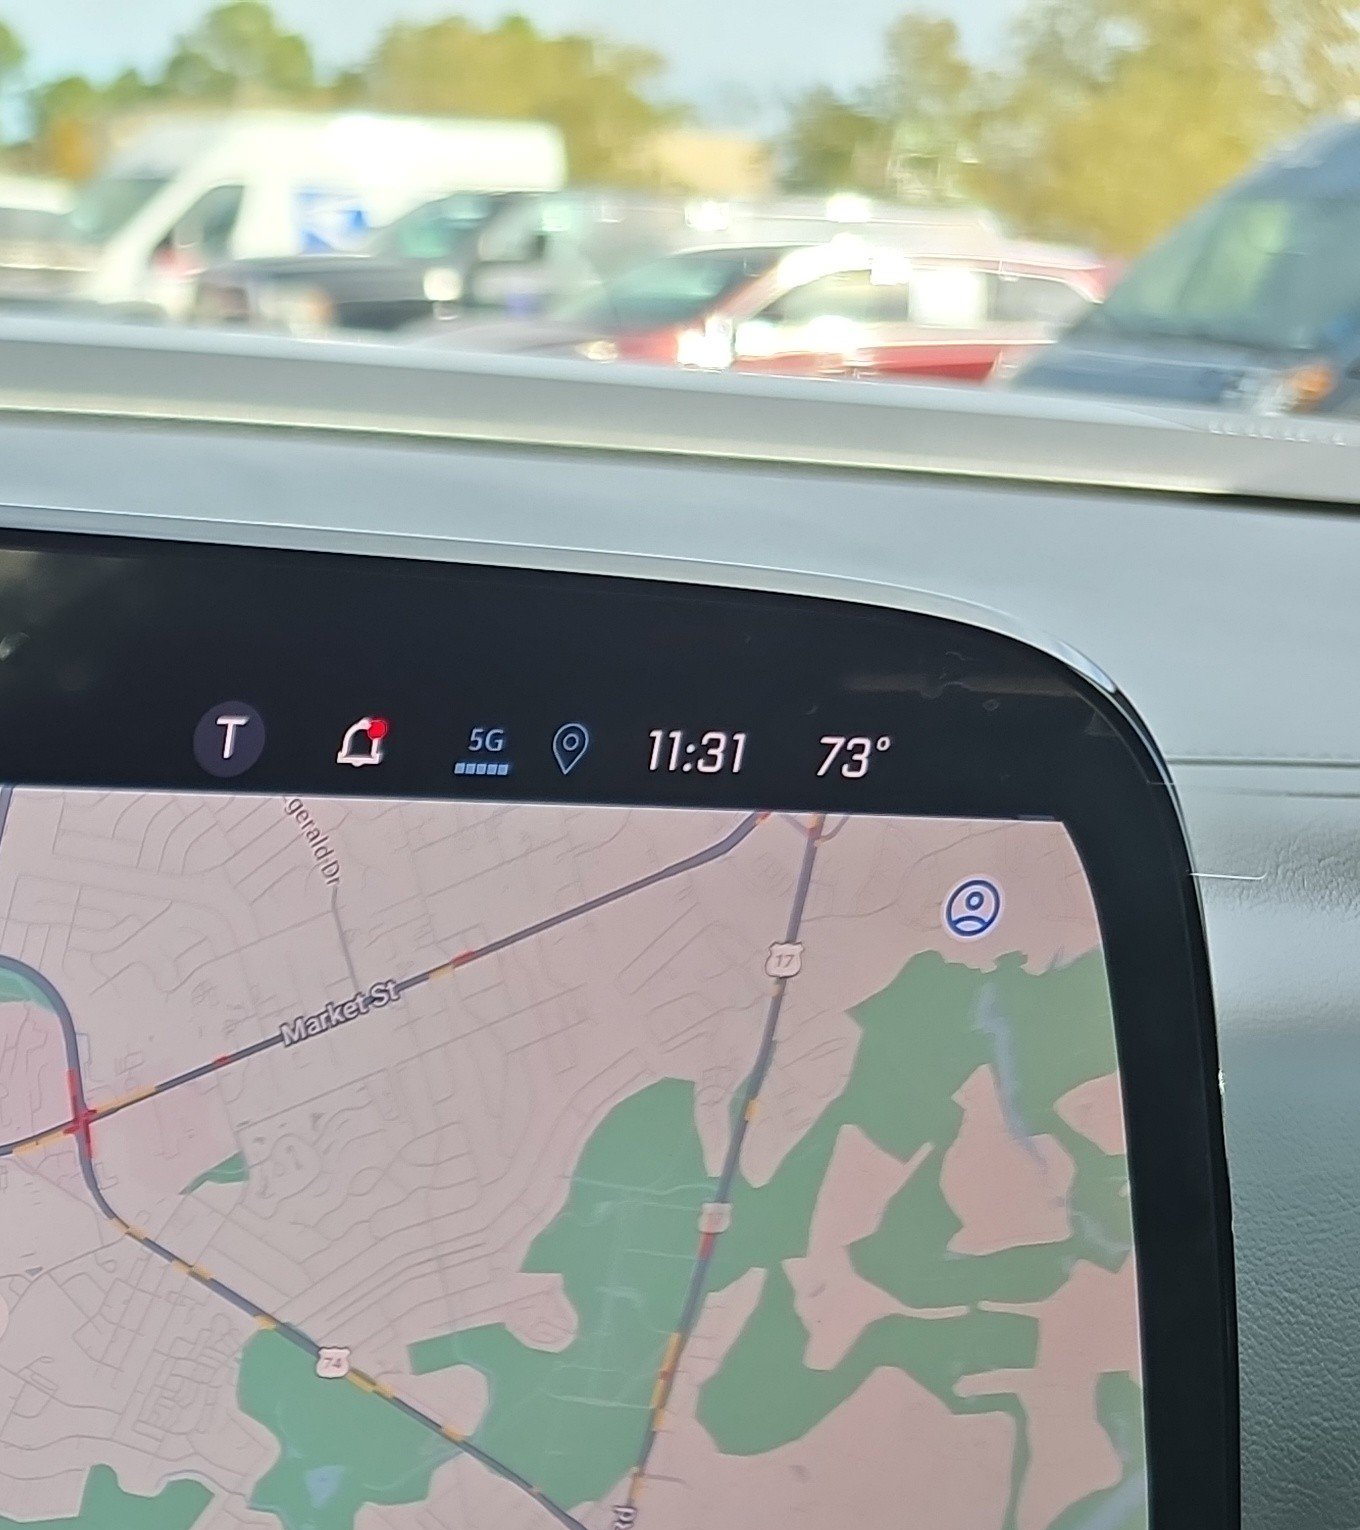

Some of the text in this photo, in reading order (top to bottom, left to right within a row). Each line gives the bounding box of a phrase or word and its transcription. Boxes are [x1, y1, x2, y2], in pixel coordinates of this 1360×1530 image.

[216, 715, 249, 760] T
[469, 728, 504, 752] 5G
[647, 730, 747, 774] 11:31
[816, 735, 892, 778] 73°
[320, 859, 340, 885] Dr
[776, 955, 794, 968] 17
[280, 979, 401, 1047] Market St
[323, 1357, 342, 1369] 74
